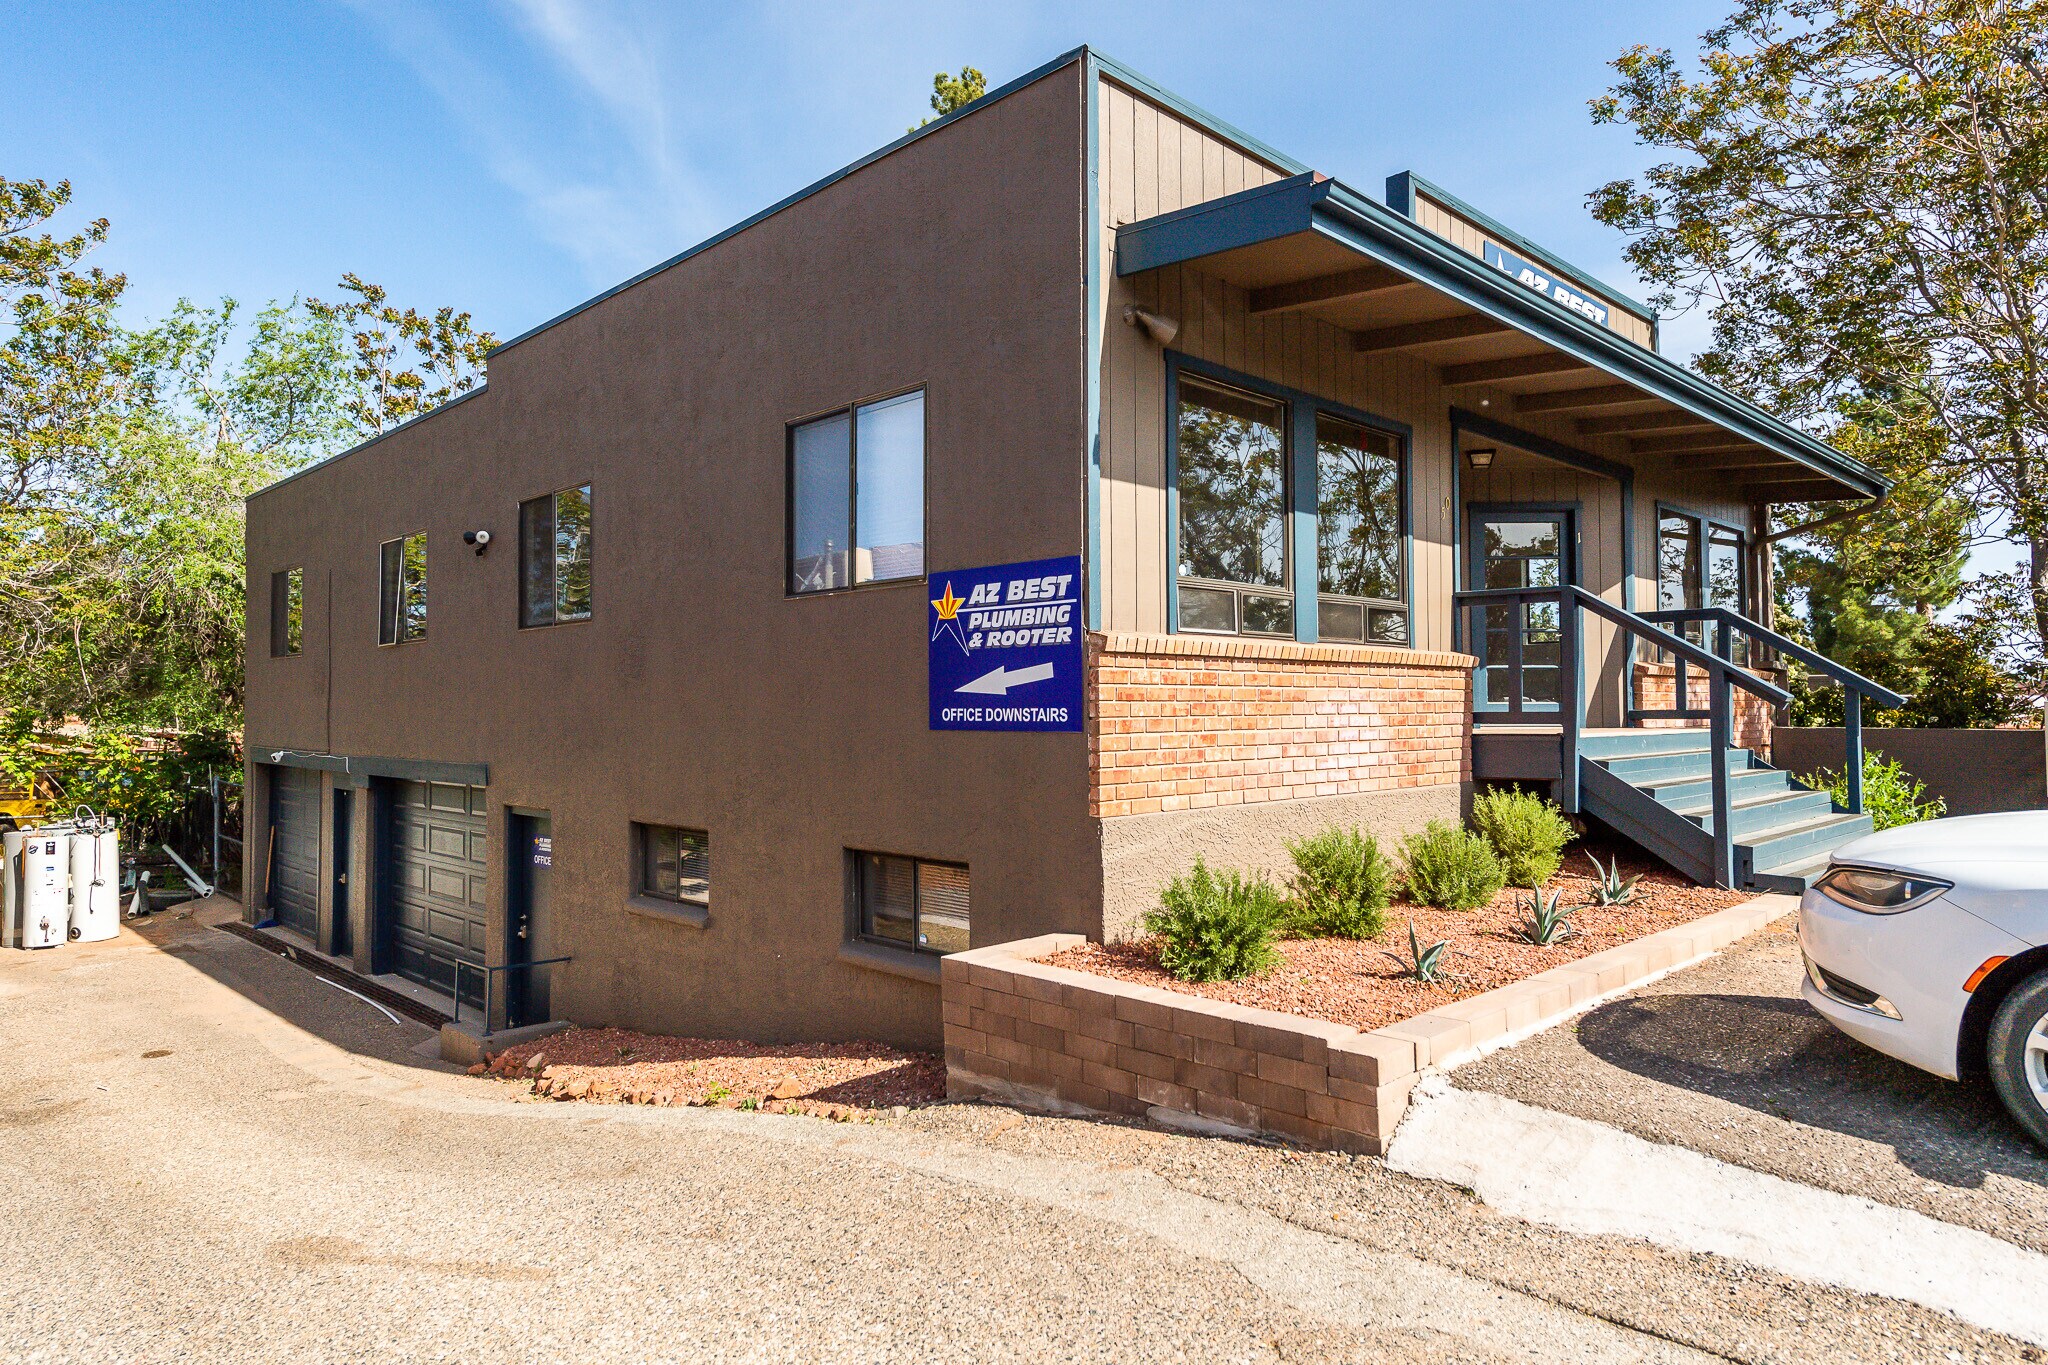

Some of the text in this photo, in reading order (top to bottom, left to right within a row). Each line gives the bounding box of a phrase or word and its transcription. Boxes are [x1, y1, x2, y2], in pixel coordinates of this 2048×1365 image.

[1518, 268, 1550, 294] AZ
[968, 574, 1072, 606] AZ BEST
[968, 605, 1071, 630] PLUMBING
[968, 626, 1072, 648] & ROOTER
[941, 708, 1068, 722] OFFICE DOWNSTAIRS
[534, 855, 552, 866] OFFICE
